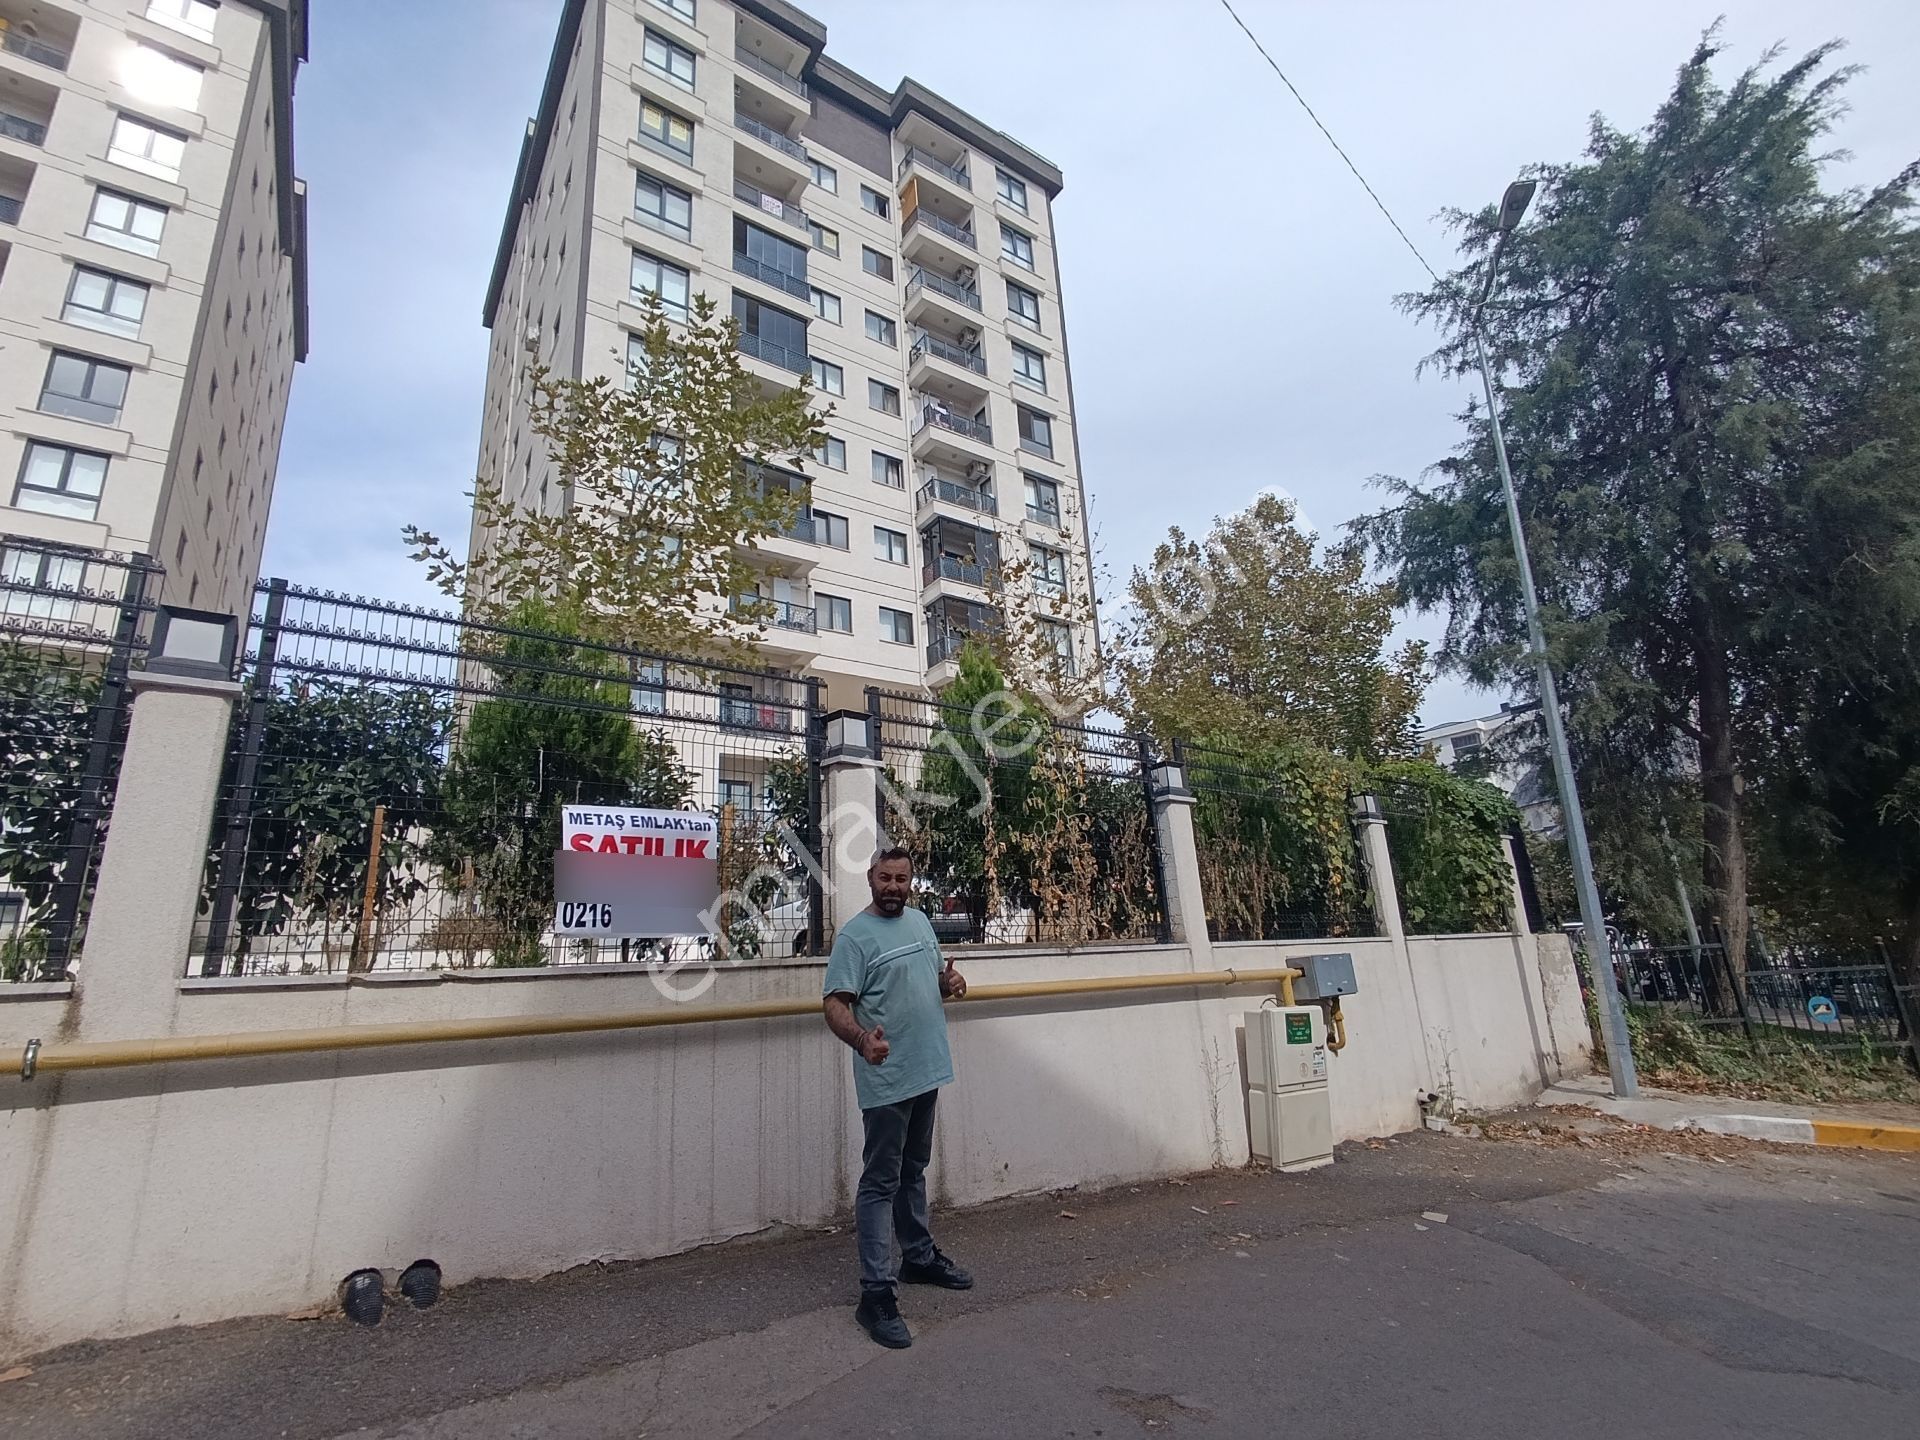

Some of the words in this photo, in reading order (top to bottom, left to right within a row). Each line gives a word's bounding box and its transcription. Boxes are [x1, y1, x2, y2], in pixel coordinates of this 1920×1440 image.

[568, 812, 625, 830] METAŞ
[631, 815, 711, 832] EMLAK'tan
[562, 902, 612, 928] 0216
